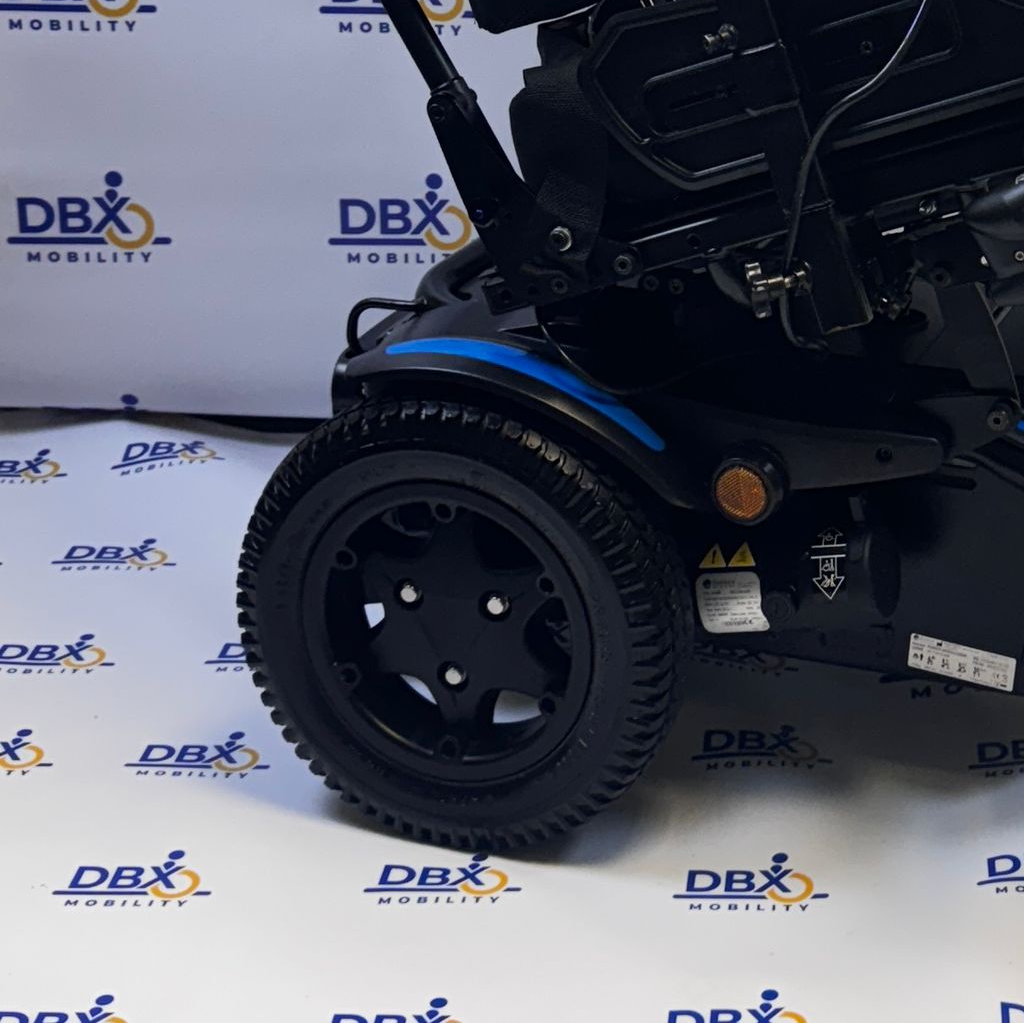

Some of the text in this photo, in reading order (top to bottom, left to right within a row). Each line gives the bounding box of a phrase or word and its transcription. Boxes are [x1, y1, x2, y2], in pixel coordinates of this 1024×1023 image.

[9, 19, 135, 31] MOBILITY
[339, 22, 461, 36] MOBTY
[17, 197, 131, 233] DBX
[340, 199, 449, 235] DBX
[27, 251, 151, 263] MOBILITY
[347, 253, 450, 263] MOBILI
[122, 441, 205, 462] DBX
[63, 545, 155, 561] DBX
[703, 729, 803, 753] DBX
[139, 744, 246, 763] DBX
[136, 770, 249, 780] MOBILITY
[69, 866, 184, 888] DBX
[378, 865, 489, 886] DBX
[686, 869, 792, 892] DBX
[64, 899, 185, 907] MOBILITY
[378, 896, 498, 905] MOBILITY
[689, 903, 809, 912] MOBILITY
